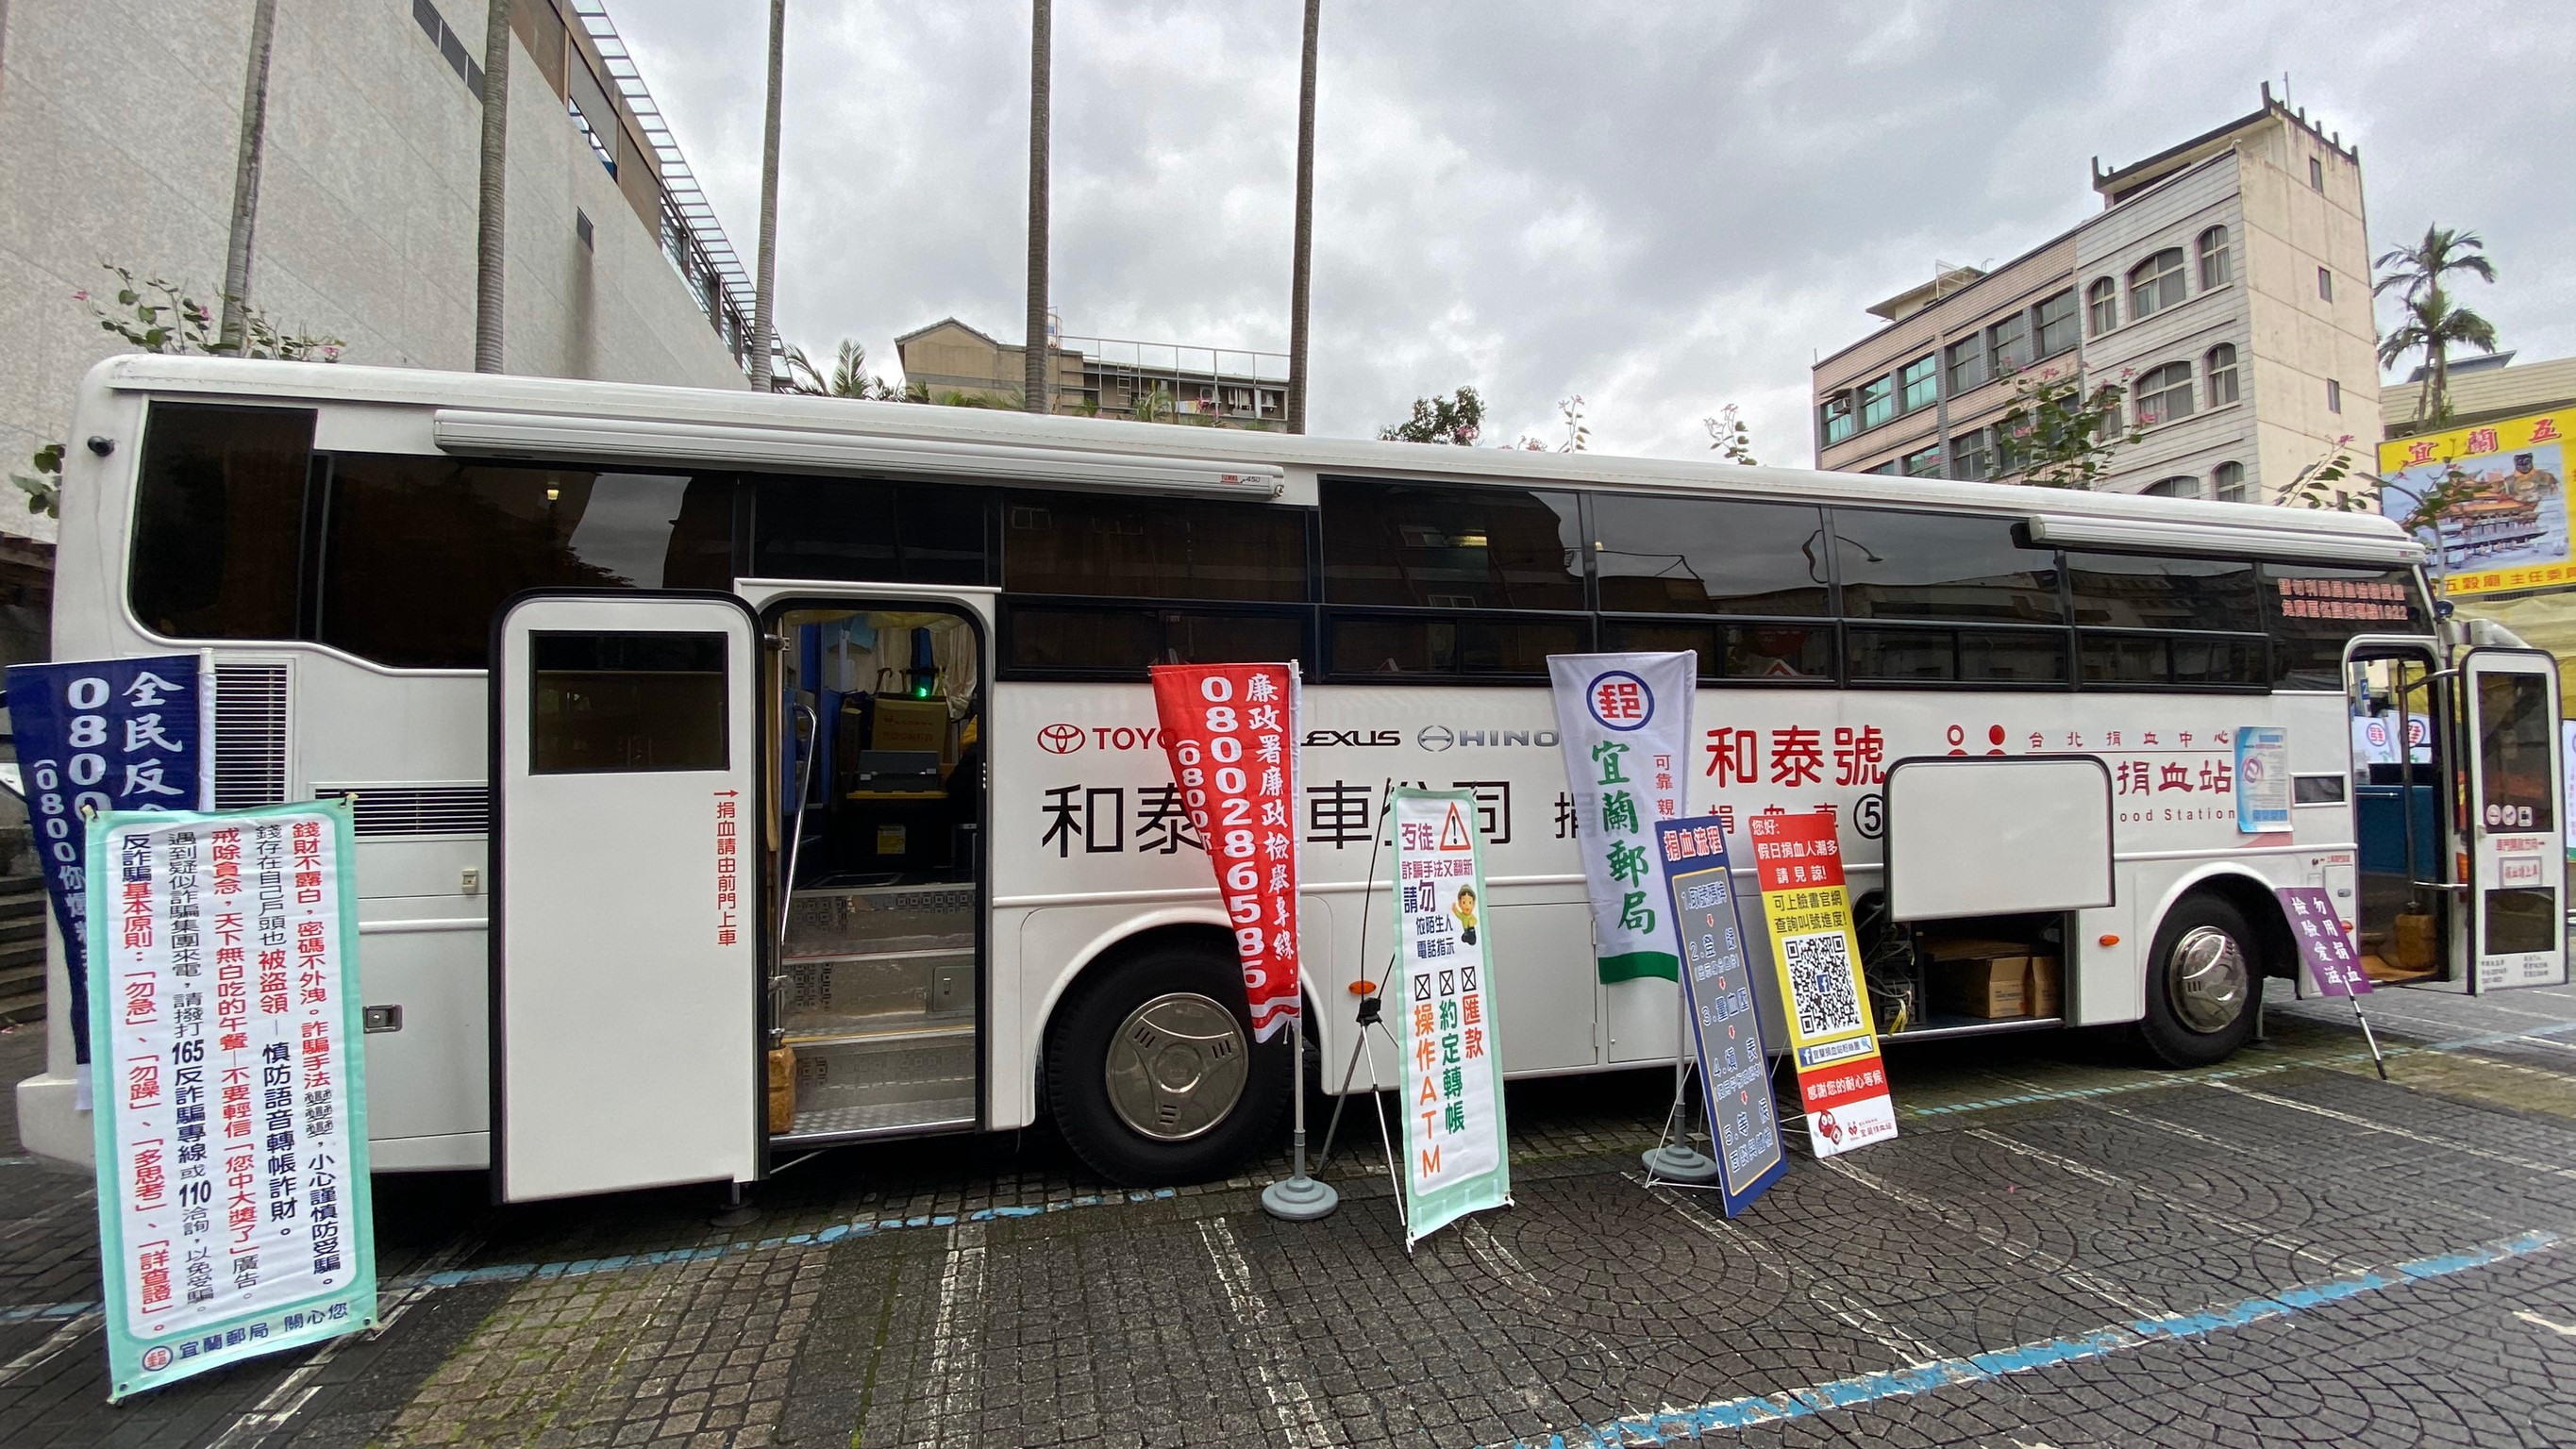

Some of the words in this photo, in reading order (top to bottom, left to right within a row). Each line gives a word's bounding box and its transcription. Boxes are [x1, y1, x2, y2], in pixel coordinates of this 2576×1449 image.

[2433, 575, 2501, 591] 五穀廟
[1597, 683, 1643, 719] 郵
[123, 672, 185, 811] 全民反
[1093, 727, 1178, 750] TOYO
[1300, 730, 1401, 746] EXUS
[1460, 729, 1560, 747] HINO
[2029, 729, 2231, 748] 台北捐血中心
[1706, 724, 1885, 788] 和泰號
[1653, 755, 1674, 791] 可靠
[2116, 760, 2233, 796] 捐血站
[1655, 798, 1676, 821] 親
[2119, 808, 2153, 823] ood
[2164, 807, 2236, 823] Station
[1201, 676, 1267, 989] 0800286586
[1401, 823, 1434, 851] 歹徒
[1591, 740, 1657, 935] 宜蘭郵局
[1664, 825, 1723, 861] 捐血流程
[1757, 840, 1838, 860] 假日捐血人潮多
[716, 801, 737, 946] 捐血請由前門上車
[1401, 858, 1473, 879] 詐騙手法又翻新
[1403, 879, 1436, 913] 請勿
[1773, 890, 1843, 911] 可上臉書官網
[1415, 915, 1453, 936] 依陌生人
[1416, 937, 1455, 959] 電話指示
[1463, 993, 1484, 1059] 匯款
[1439, 1000, 1465, 1135] 約定轉帳
[1807, 1070, 1883, 1100] 感謝您的耐心等候
[179, 1323, 269, 1359] 宜蘭郵局
[284, 1302, 348, 1333] 關心您
